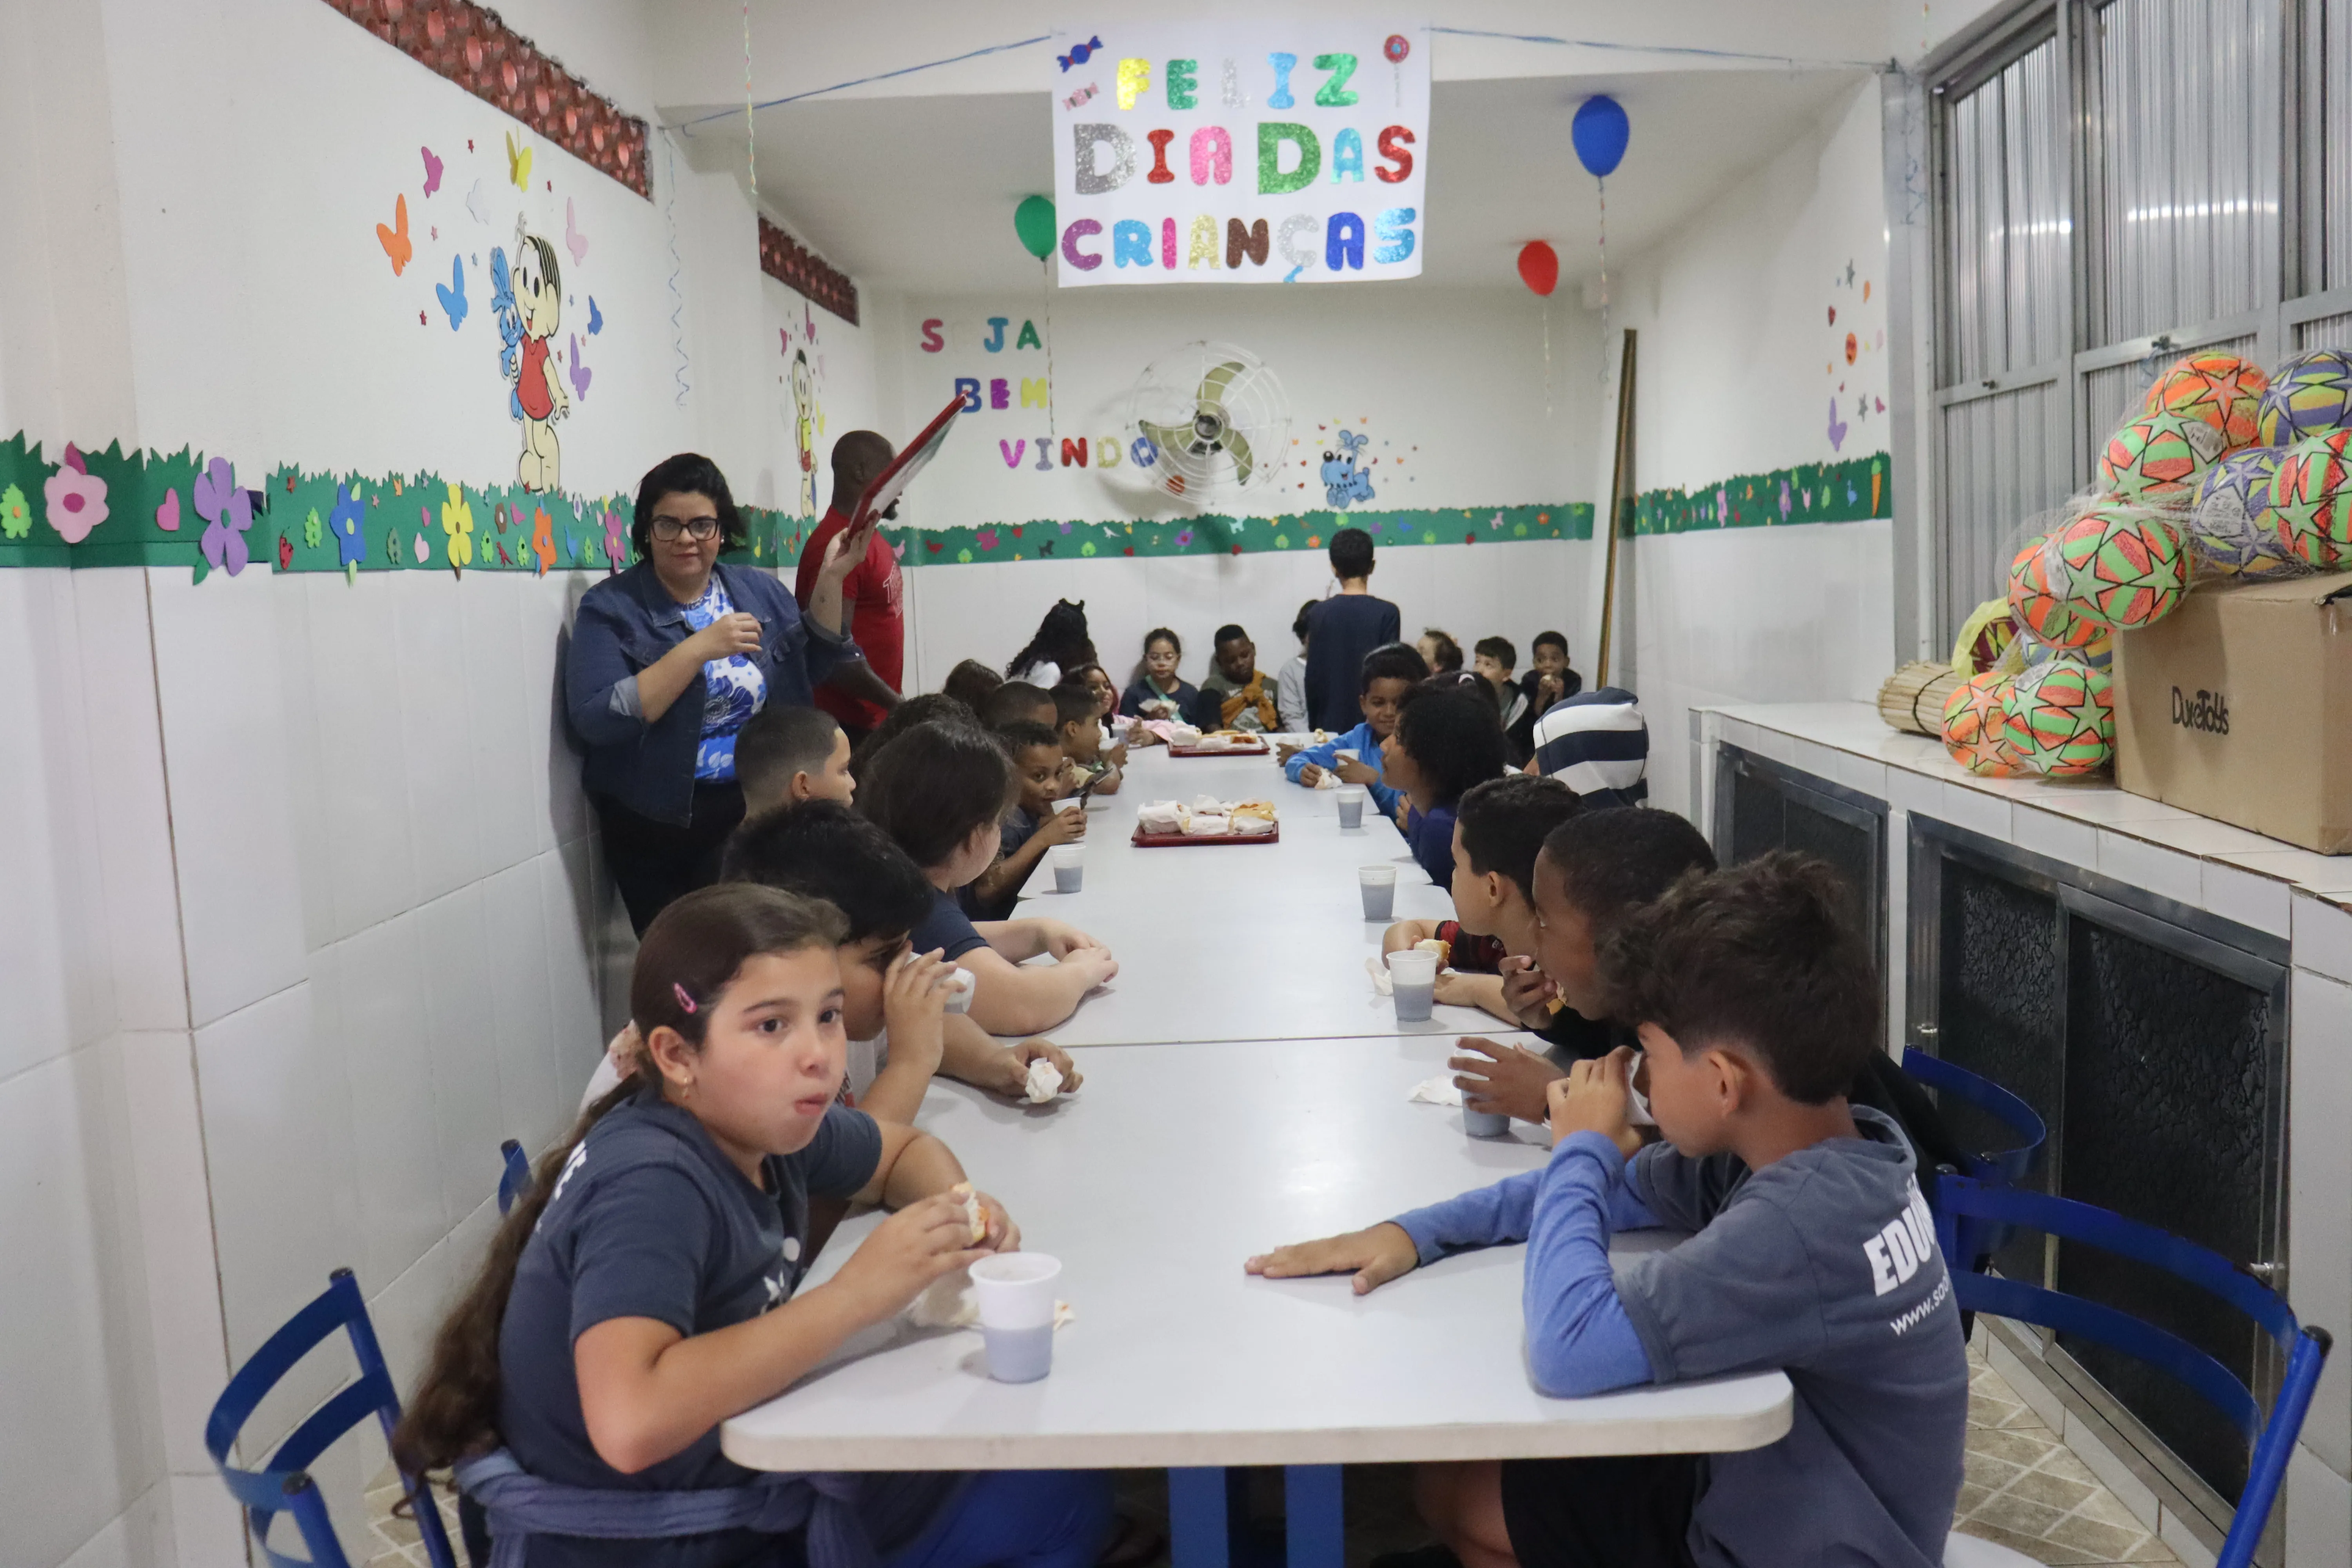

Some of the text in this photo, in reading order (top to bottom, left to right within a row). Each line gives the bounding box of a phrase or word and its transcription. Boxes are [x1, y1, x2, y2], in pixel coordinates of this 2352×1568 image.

[1117, 52, 1358, 110] FELIZ
[1074, 122, 1416, 194] DIA DAS
[1062, 207, 1416, 283] CRIANÇAS
[955, 378, 1047, 413] BEM
[999, 437, 1158, 470] VINDO
